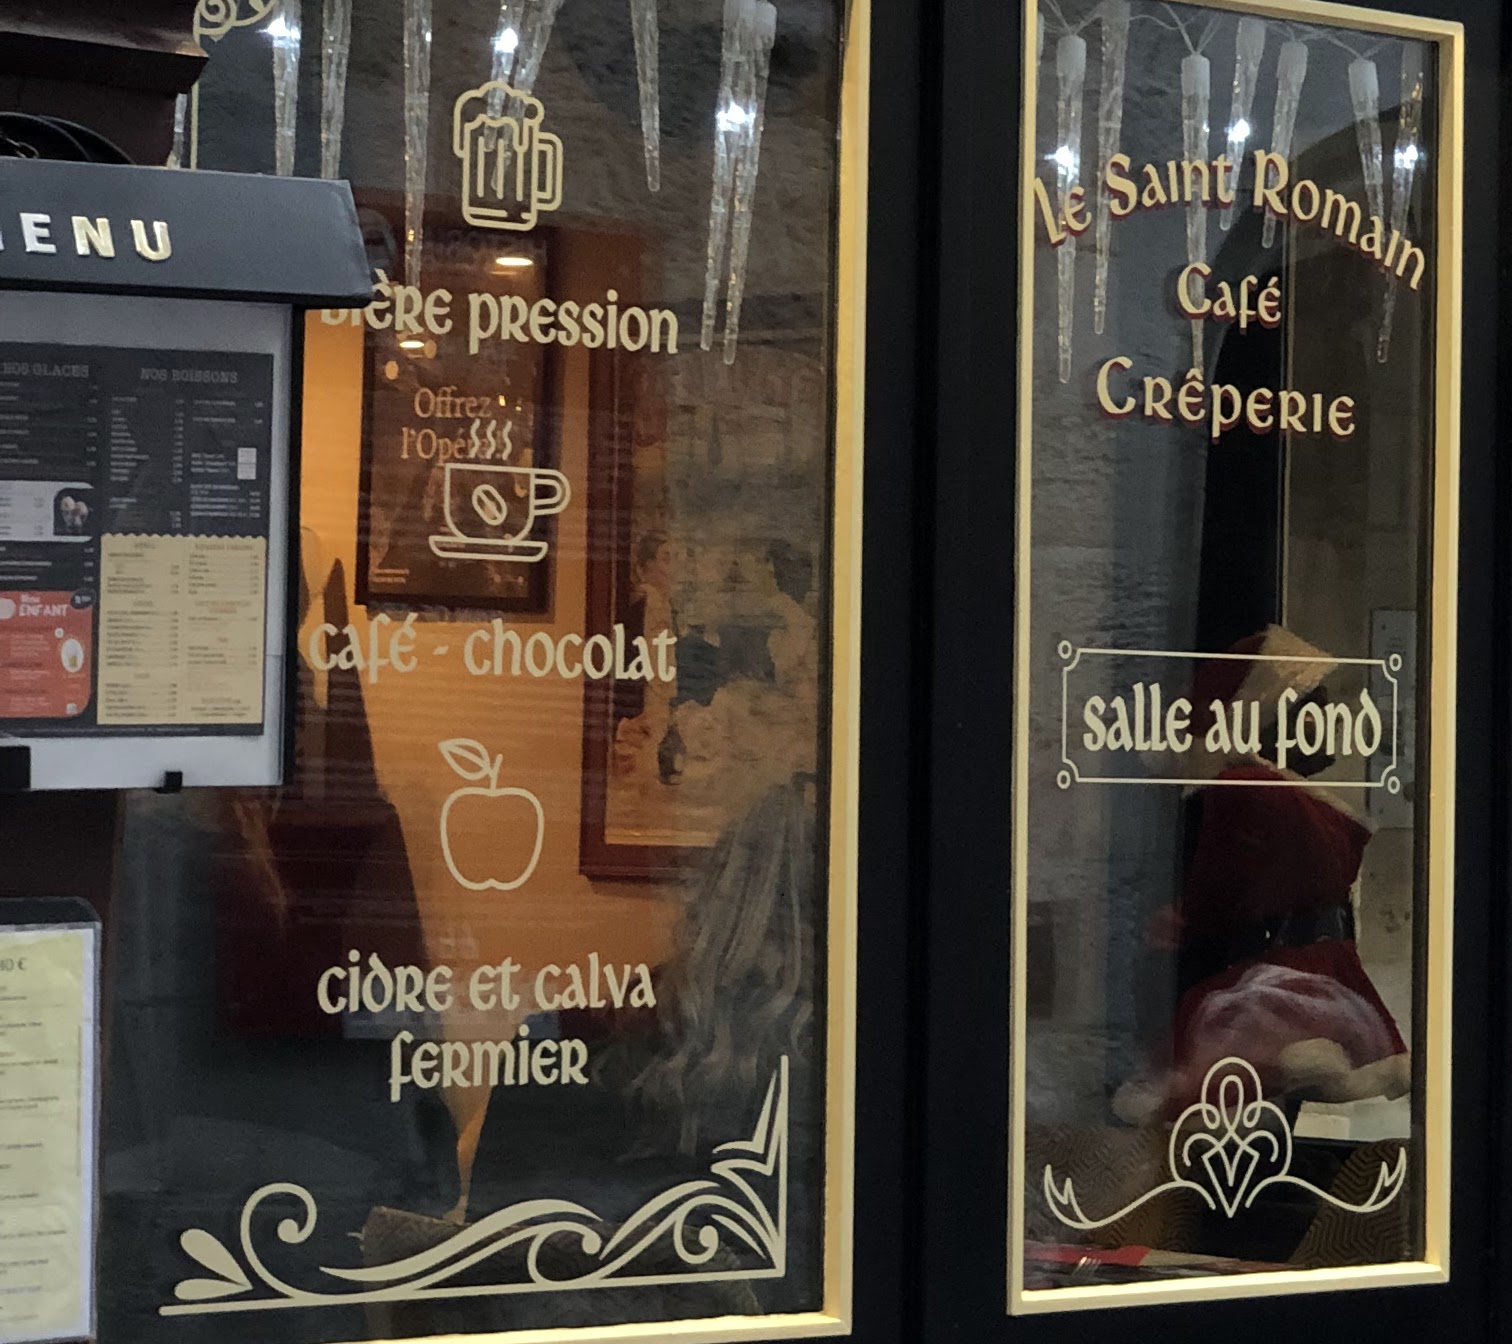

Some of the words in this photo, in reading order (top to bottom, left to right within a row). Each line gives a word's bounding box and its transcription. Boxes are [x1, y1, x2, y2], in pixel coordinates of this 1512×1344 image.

[0, 212, 173, 262] ENU
[1033, 177, 1092, 249] Le
[1104, 152, 1236, 220] Saint
[1253, 149, 1426, 291] Romain
[468, 288, 679, 355] pression
[1177, 261, 1281, 335] Café
[414, 386, 492, 418] Offrez
[1096, 356, 1355, 443] Crêperie
[308, 611, 419, 684] café
[463, 618, 678, 683] chocolat
[1082, 682, 1193, 753] salle
[1204, 697, 1262, 754] au
[1275, 687, 1382, 769] fond
[316, 948, 454, 1015] cidre
[468, 956, 522, 1011] et
[533, 951, 657, 1012] calva
[388, 1023, 589, 1103] fermier
